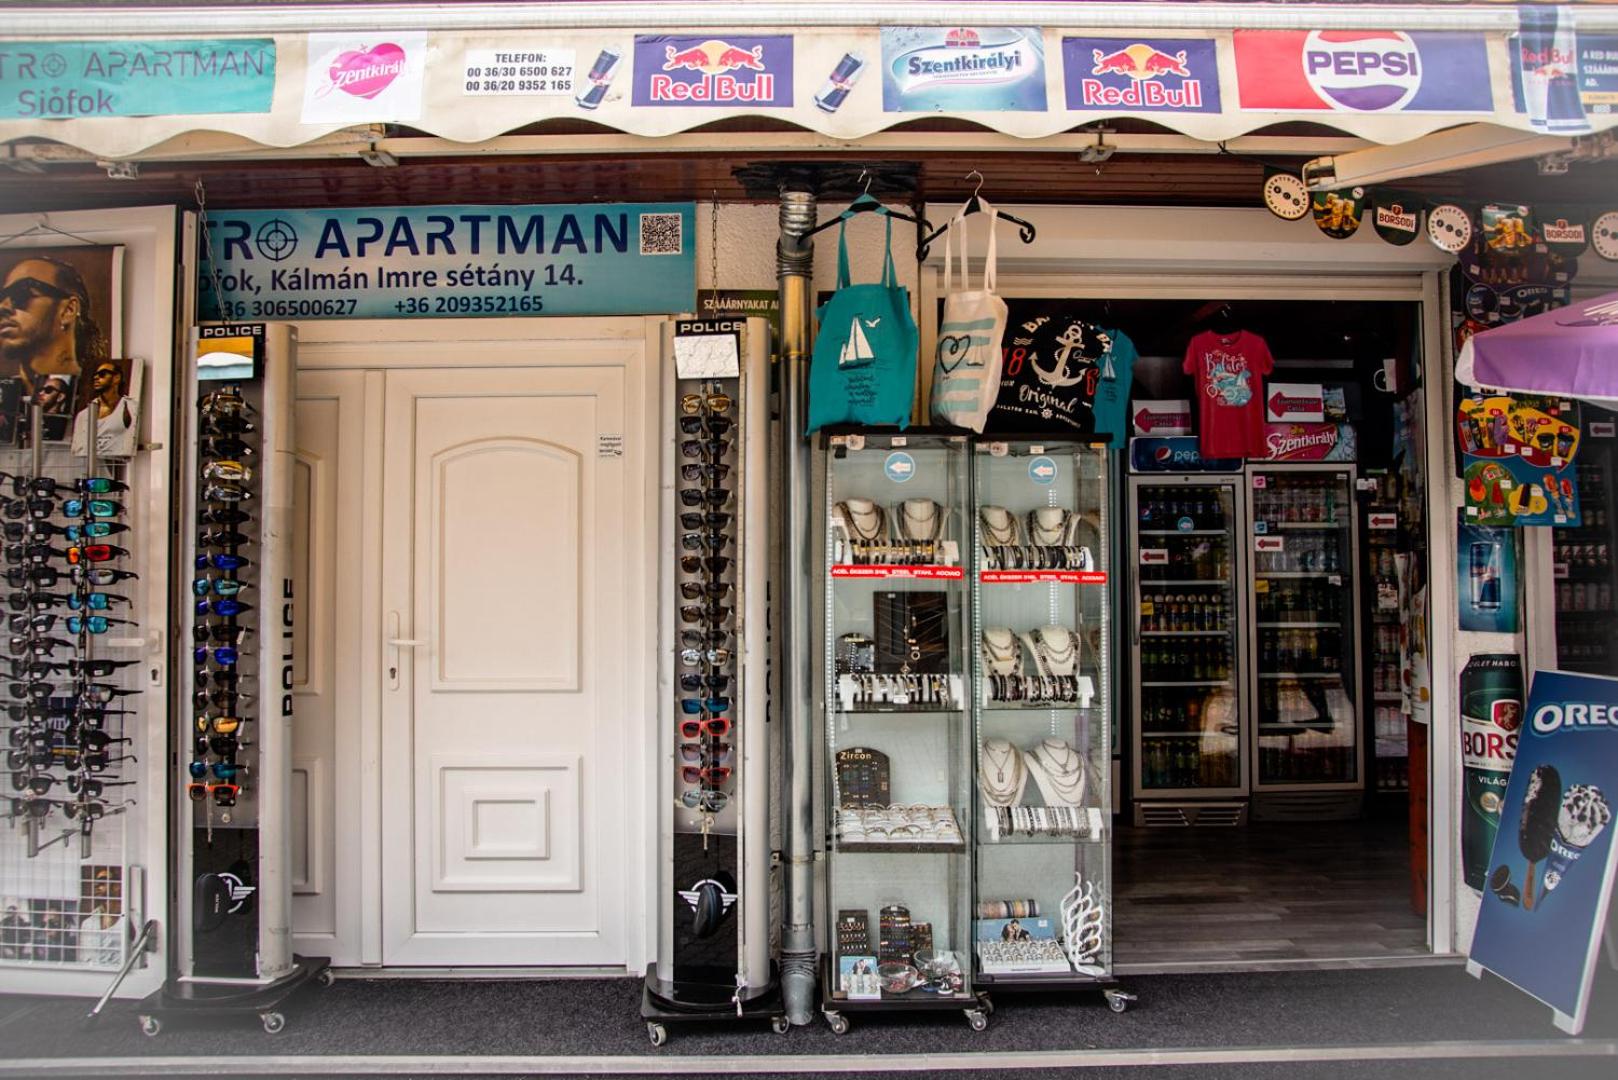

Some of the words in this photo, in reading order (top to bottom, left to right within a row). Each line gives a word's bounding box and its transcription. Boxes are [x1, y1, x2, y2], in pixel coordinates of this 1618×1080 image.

[84, 50, 264, 78] APARTMAN
[495, 53, 547, 63] TELEFON:
[908, 51, 1022, 75] Szentkirályi
[1307, 51, 1418, 76] PEPSI
[1552, 48, 1574, 64] Bul
[467, 67, 481, 77] 00
[484, 67, 516, 77] 36/30
[519, 66, 548, 77] 6500
[551, 66, 572, 76] 627
[466, 81, 480, 91] 00
[484, 81, 515, 91] 36/20
[519, 81, 546, 91] 9352
[551, 80, 571, 90] 165
[651, 74, 711, 100] Red
[714, 74, 774, 101] Bull
[1082, 79, 1142, 105] Red
[1143, 79, 1203, 107] Bull
[17, 86, 115, 116] Siófok
[1379, 212, 1414, 228] BORSODI
[315, 214, 628, 259] APARTMAN
[271, 267, 369, 291] Kálmán
[378, 266, 438, 288] Imre
[446, 263, 535, 291] sétány
[544, 264, 584, 286] 14.
[252, 299, 357, 316] 306500627
[394, 297, 429, 314] +36
[435, 295, 543, 313] 209352165
[204, 326, 262, 337] POLICE
[680, 322, 741, 333] POLICE
[1019, 384, 1078, 413] Original
[1174, 449, 1200, 463] pep
[840, 751, 872, 760] Zircon
[1463, 732, 1519, 760] BORS
[1479, 776, 1509, 786] VILÁG
